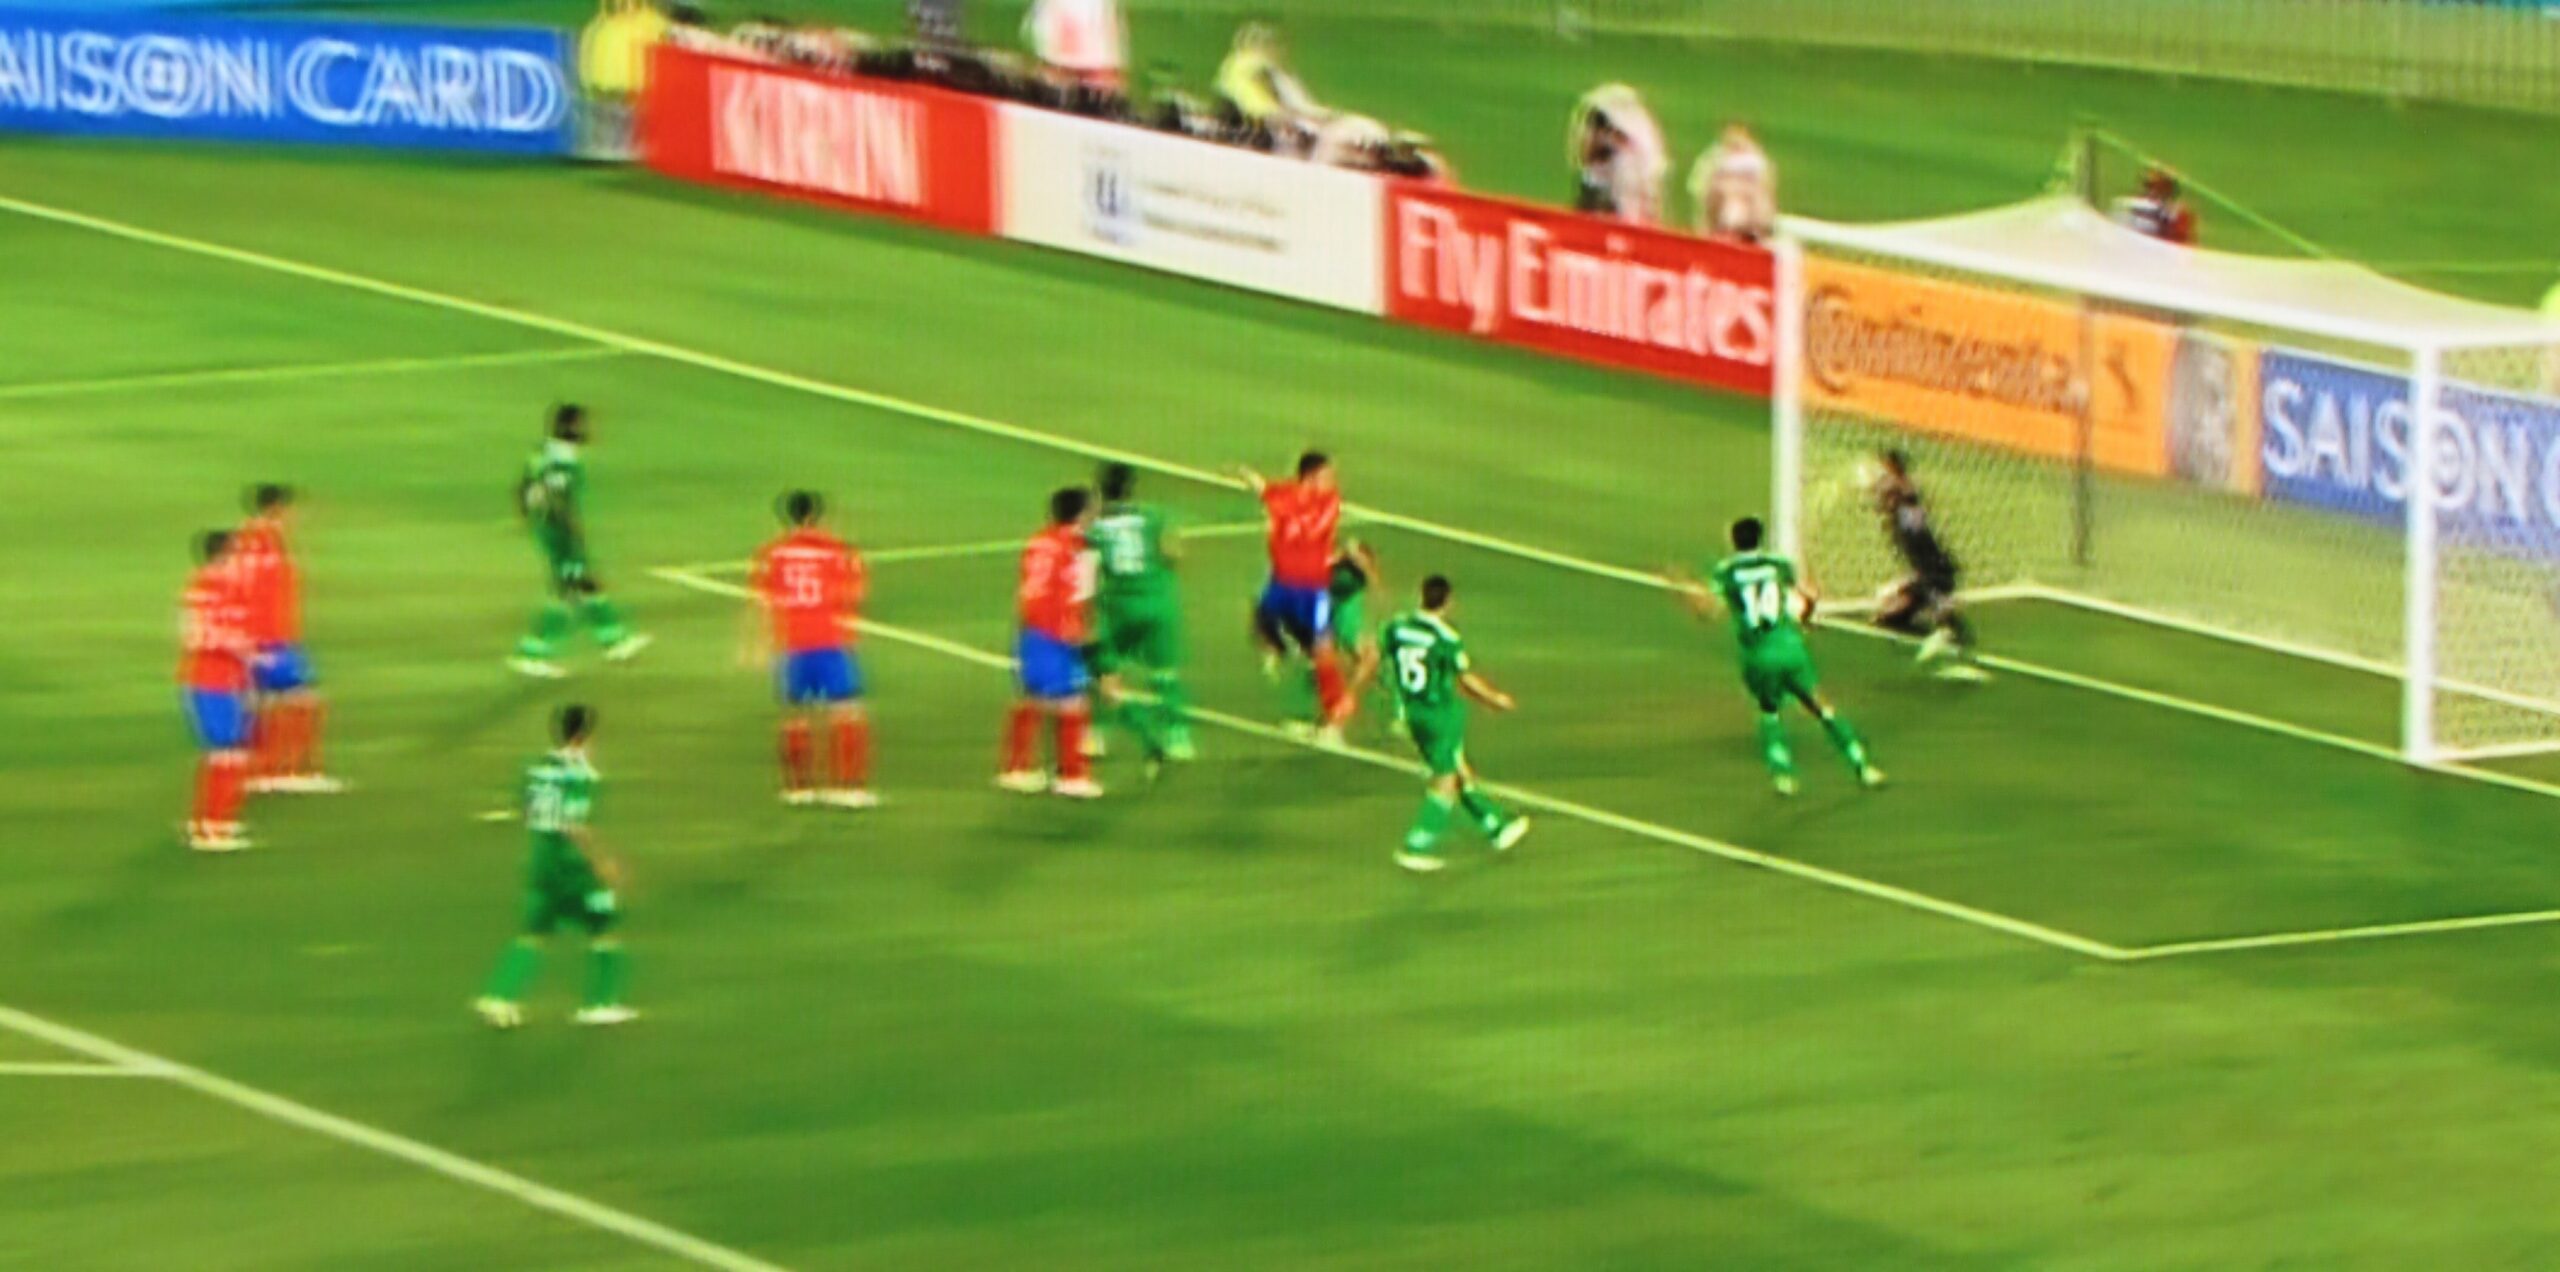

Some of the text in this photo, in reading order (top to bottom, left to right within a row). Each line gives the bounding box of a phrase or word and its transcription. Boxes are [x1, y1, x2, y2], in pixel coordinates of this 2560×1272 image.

[286, 38, 562, 132] CARD
[1401, 199, 1771, 365] Fly Emirates
[1742, 579, 1780, 628] 14
[1397, 645, 1428, 693] 15
